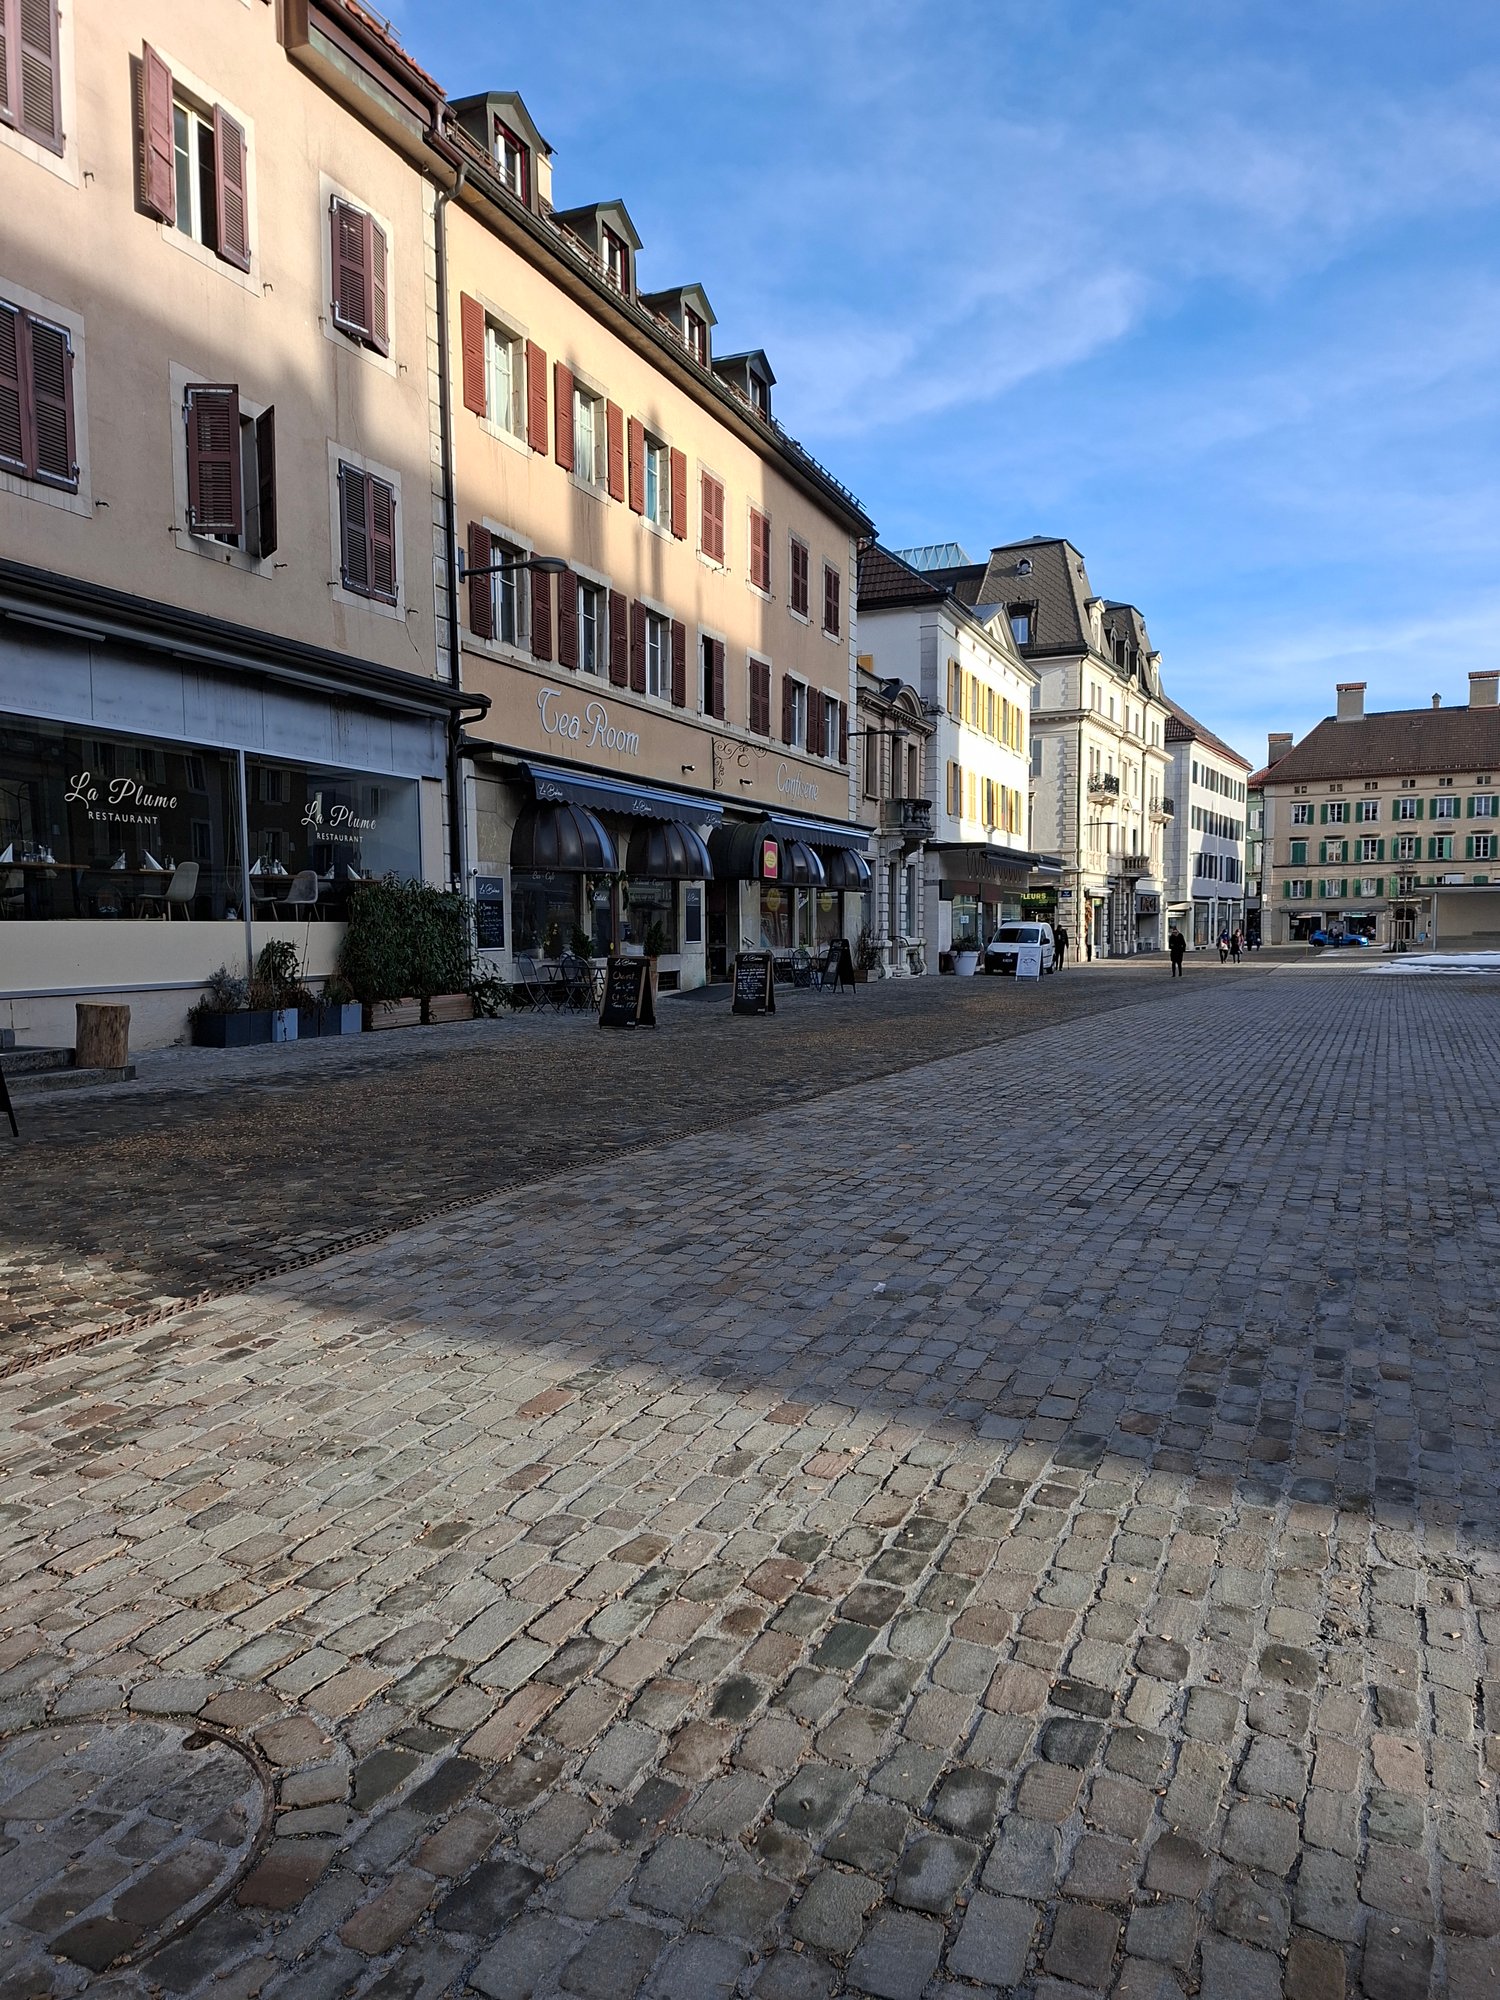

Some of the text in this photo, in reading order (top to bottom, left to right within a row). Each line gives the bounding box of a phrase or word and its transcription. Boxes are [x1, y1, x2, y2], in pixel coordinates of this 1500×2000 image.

[537, 687, 640, 756] Tea-Room
[64, 771, 178, 810] La Plume
[777, 762, 819, 802] Confiserie
[88, 810, 159, 825] RESTAURANT
[300, 800, 377, 832] La Plume
[316, 832, 363, 843] RESTAURANT
[1021, 892, 1047, 900] FLEURS
